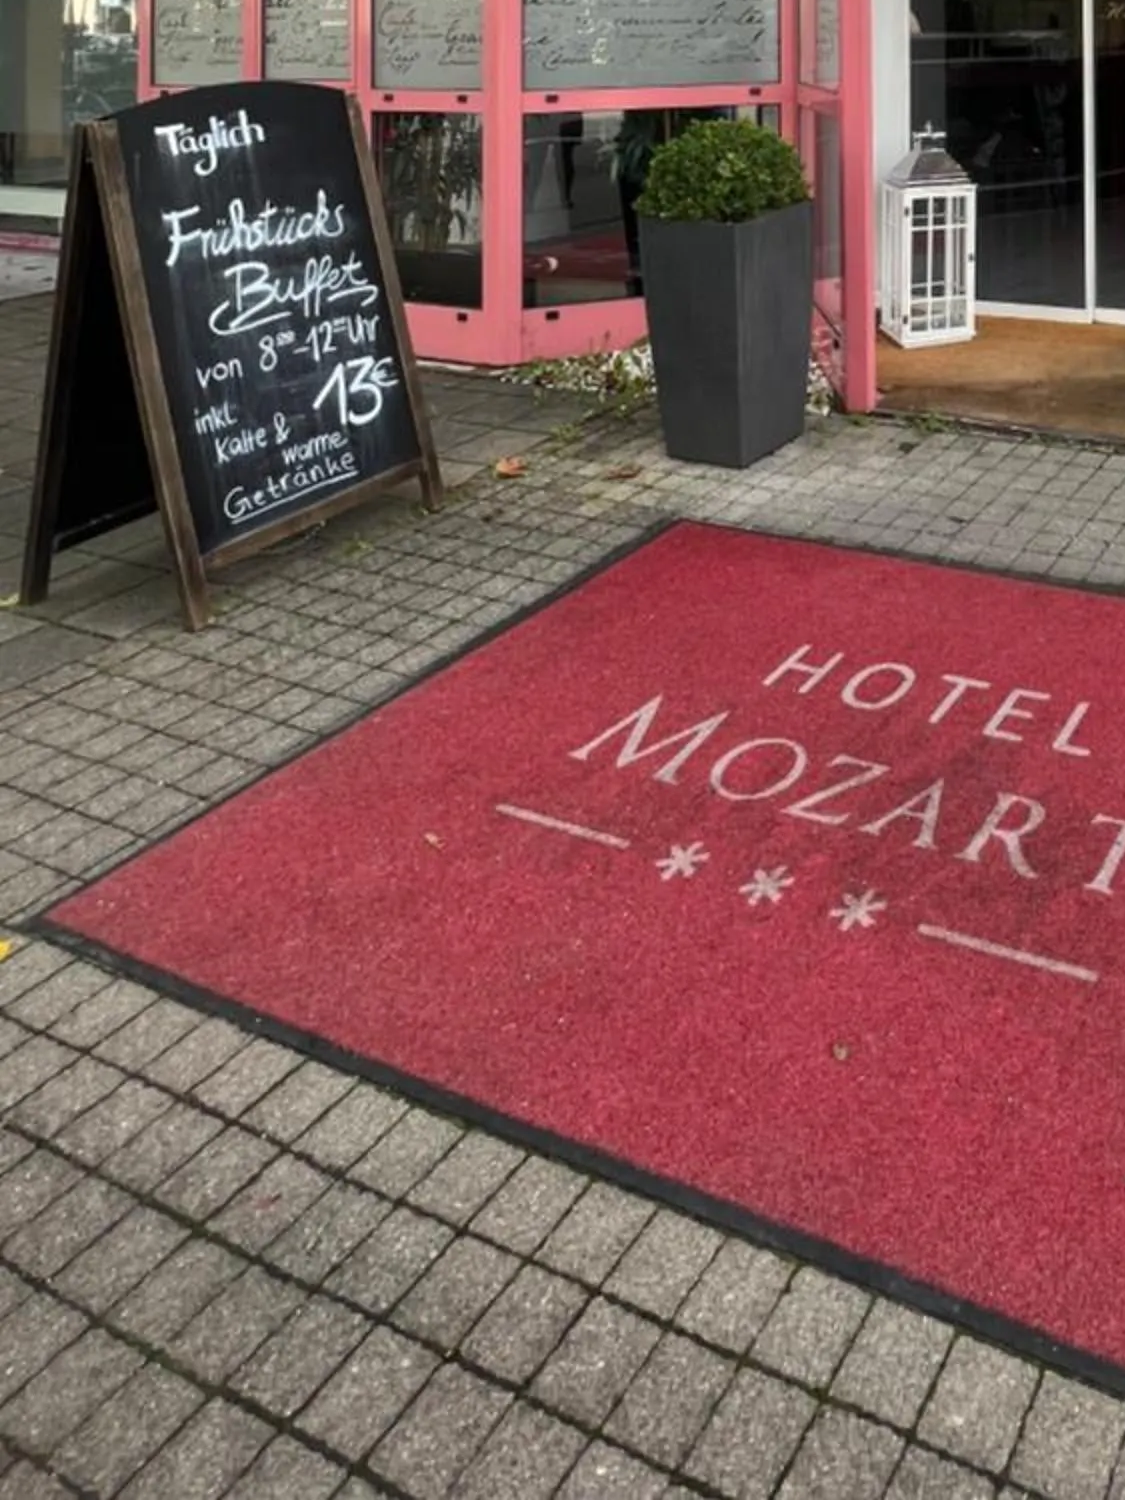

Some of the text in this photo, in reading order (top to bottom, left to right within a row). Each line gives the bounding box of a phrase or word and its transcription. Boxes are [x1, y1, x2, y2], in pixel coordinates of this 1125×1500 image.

[155, 109, 264, 175] Täglich
[162, 189, 345, 266] Frühstücks
[212, 257, 377, 330] Buffet
[196, 358, 243, 388] von
[222, 452, 357, 520] Getränke
[762, 643, 1092, 758] HOTEL
